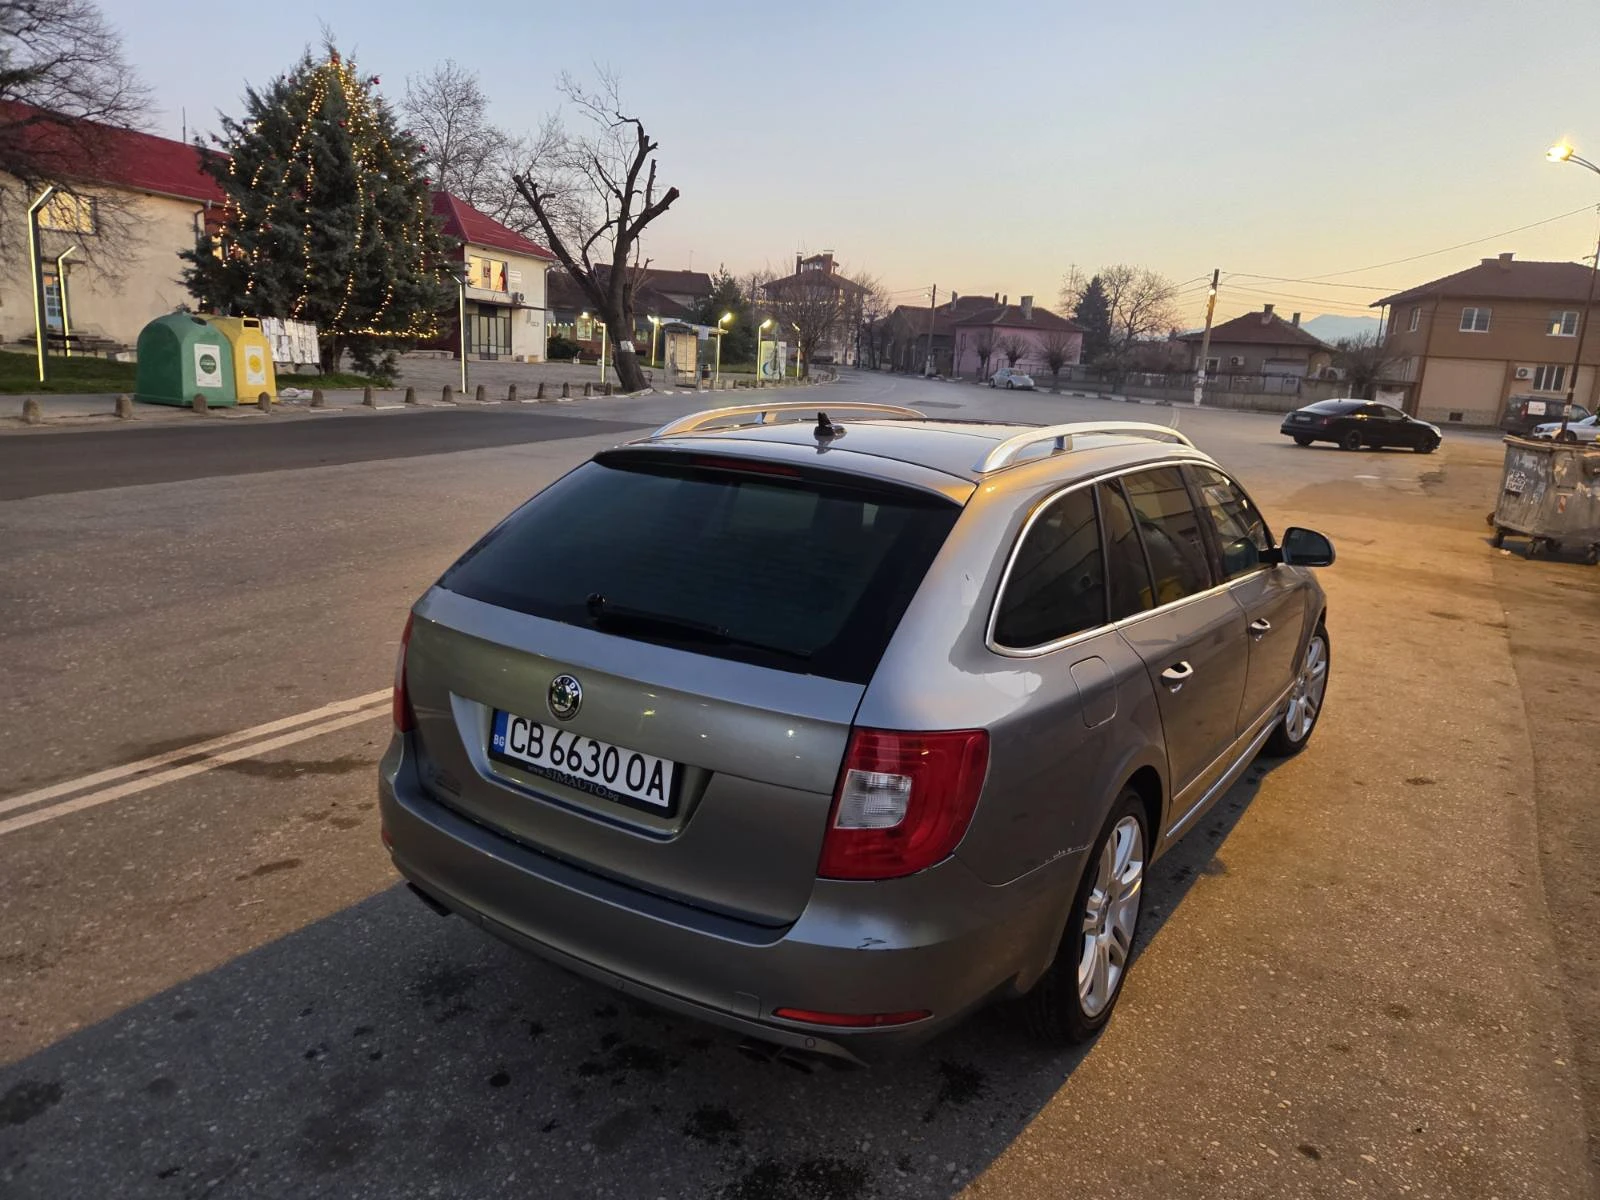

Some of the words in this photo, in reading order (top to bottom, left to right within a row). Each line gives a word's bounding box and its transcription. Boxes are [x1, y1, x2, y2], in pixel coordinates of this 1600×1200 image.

[493, 733, 506, 747] BG
[510, 717, 545, 759] CB
[549, 730, 620, 784] 6630
[625, 753, 665, 801] OA
